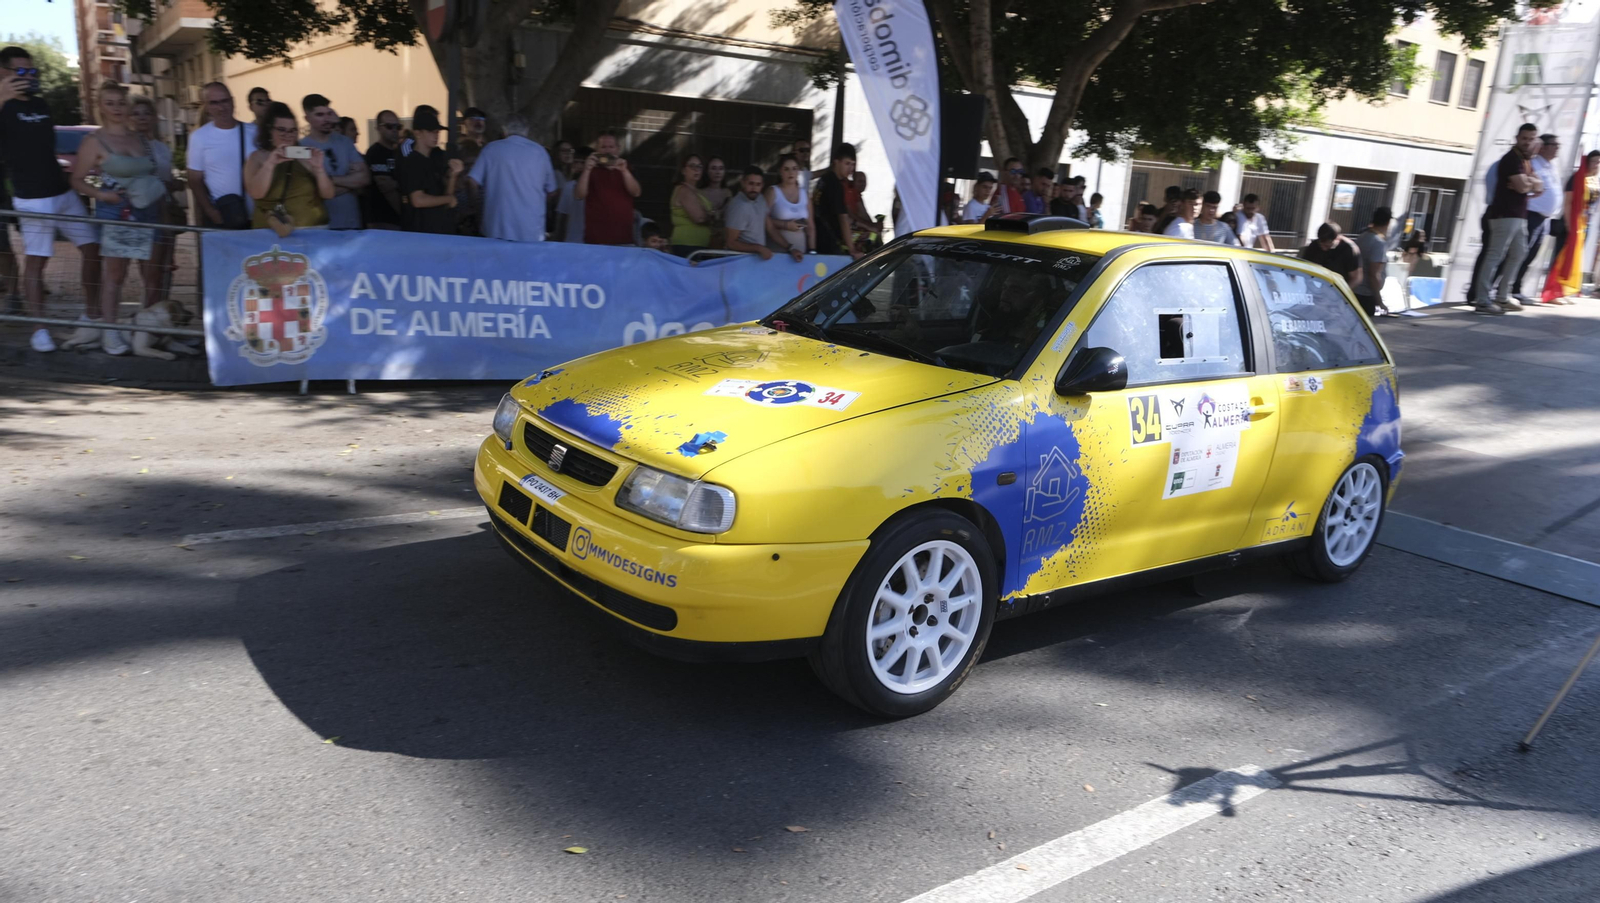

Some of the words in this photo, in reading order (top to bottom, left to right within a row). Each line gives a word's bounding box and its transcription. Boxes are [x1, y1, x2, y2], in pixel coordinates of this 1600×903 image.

[350, 272, 606, 309] AYUNTAMIENTO
[351, 307, 398, 336] DE
[406, 308, 552, 339] ALMERÍA
[817, 391, 847, 406] 34
[1130, 396, 1161, 444] 34
[1165, 421, 1195, 431] CUPRA
[588, 542, 678, 588] MMVDESIGNS
